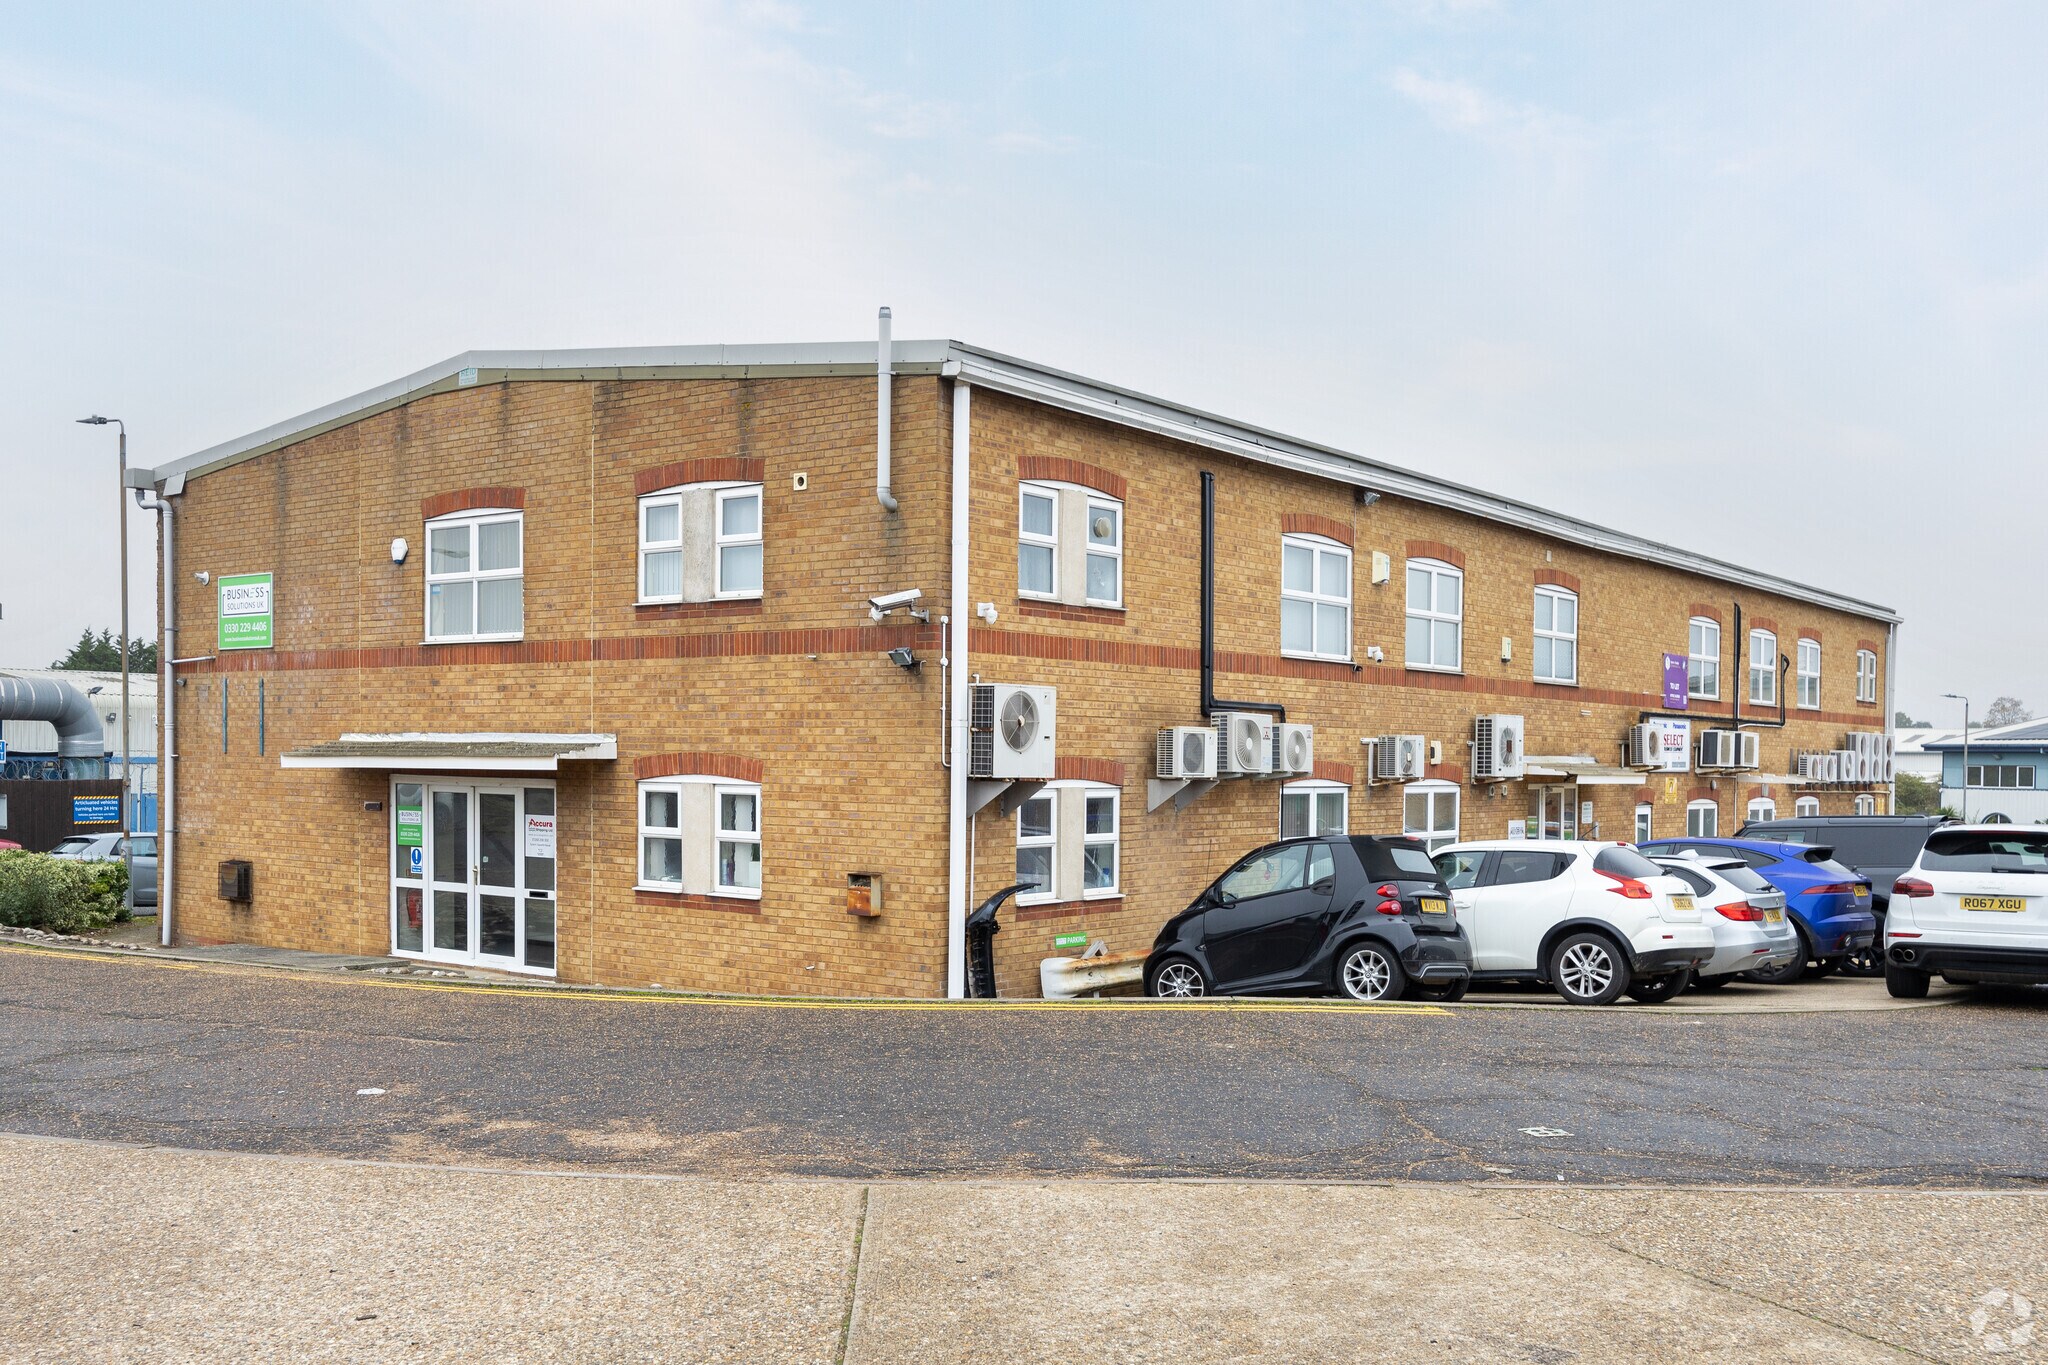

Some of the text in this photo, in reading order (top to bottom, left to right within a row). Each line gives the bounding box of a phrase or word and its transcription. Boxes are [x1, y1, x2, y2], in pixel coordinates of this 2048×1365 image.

[227, 587, 264, 600] BUSINESS
[227, 602, 255, 610] SOLUTIONS
[225, 621, 267, 633] 0330 229 4406
[1664, 734, 1684, 746] SELECT
[529, 818, 553, 827] Accura
[1964, 897, 2021, 909] RO67 XGU
[1068, 935, 1086, 944] PARKING
